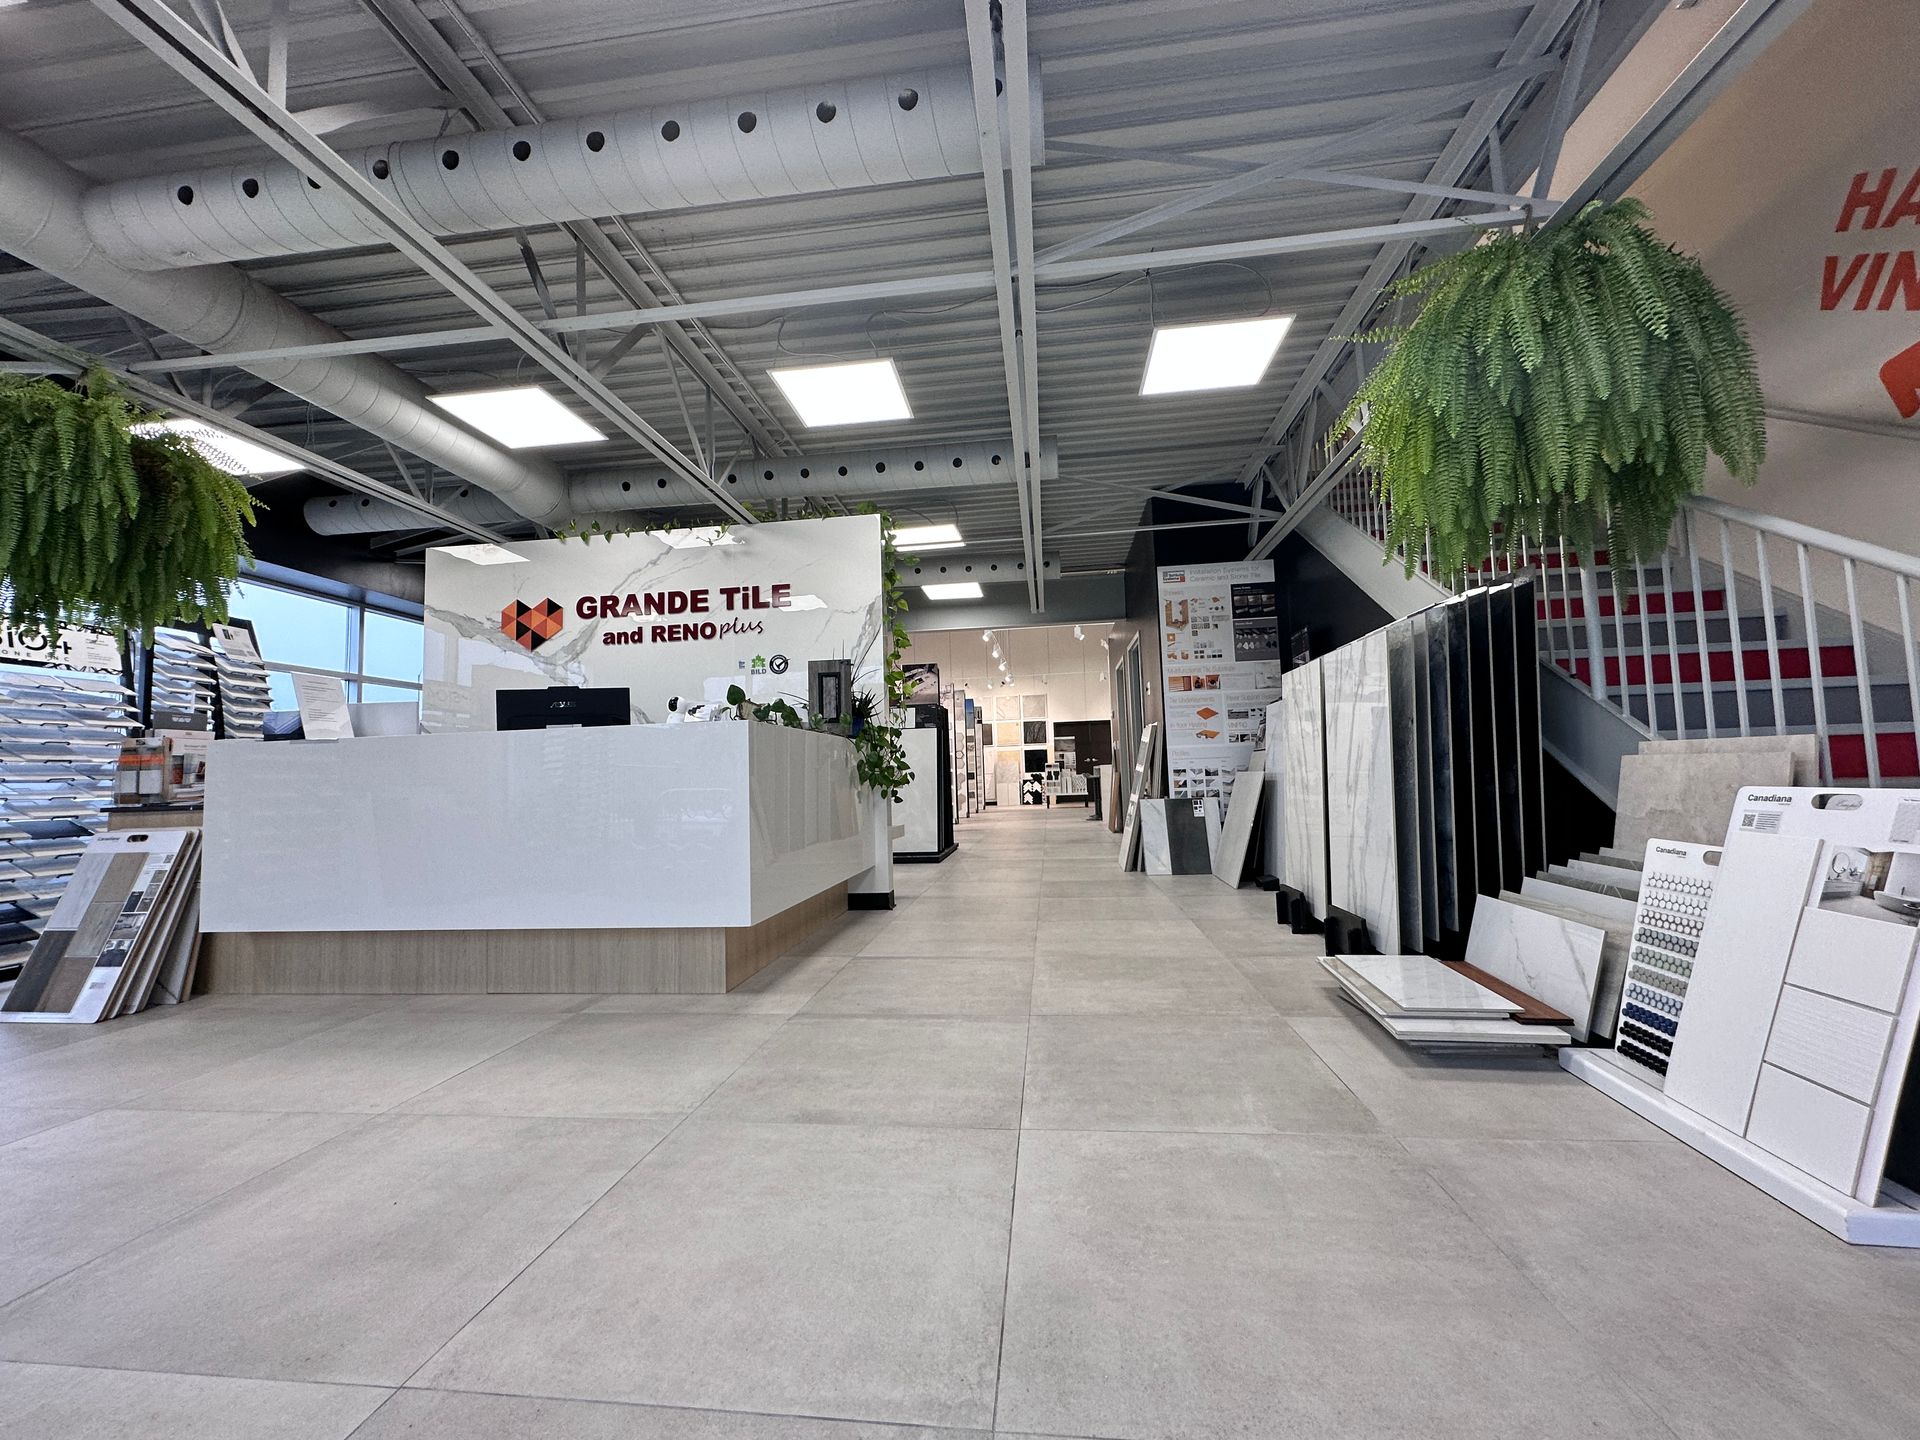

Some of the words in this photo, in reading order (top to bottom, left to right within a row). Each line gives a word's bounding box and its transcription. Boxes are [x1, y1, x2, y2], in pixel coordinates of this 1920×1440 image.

[1835, 167, 1920, 232] HA
[1820, 251, 1920, 311] VIN
[576, 588, 710, 619] GRANDE
[602, 627, 643, 645] and
[651, 622, 717, 643] RENO
[719, 617, 764, 639] plus
[1747, 793, 1793, 803] Canadiana
